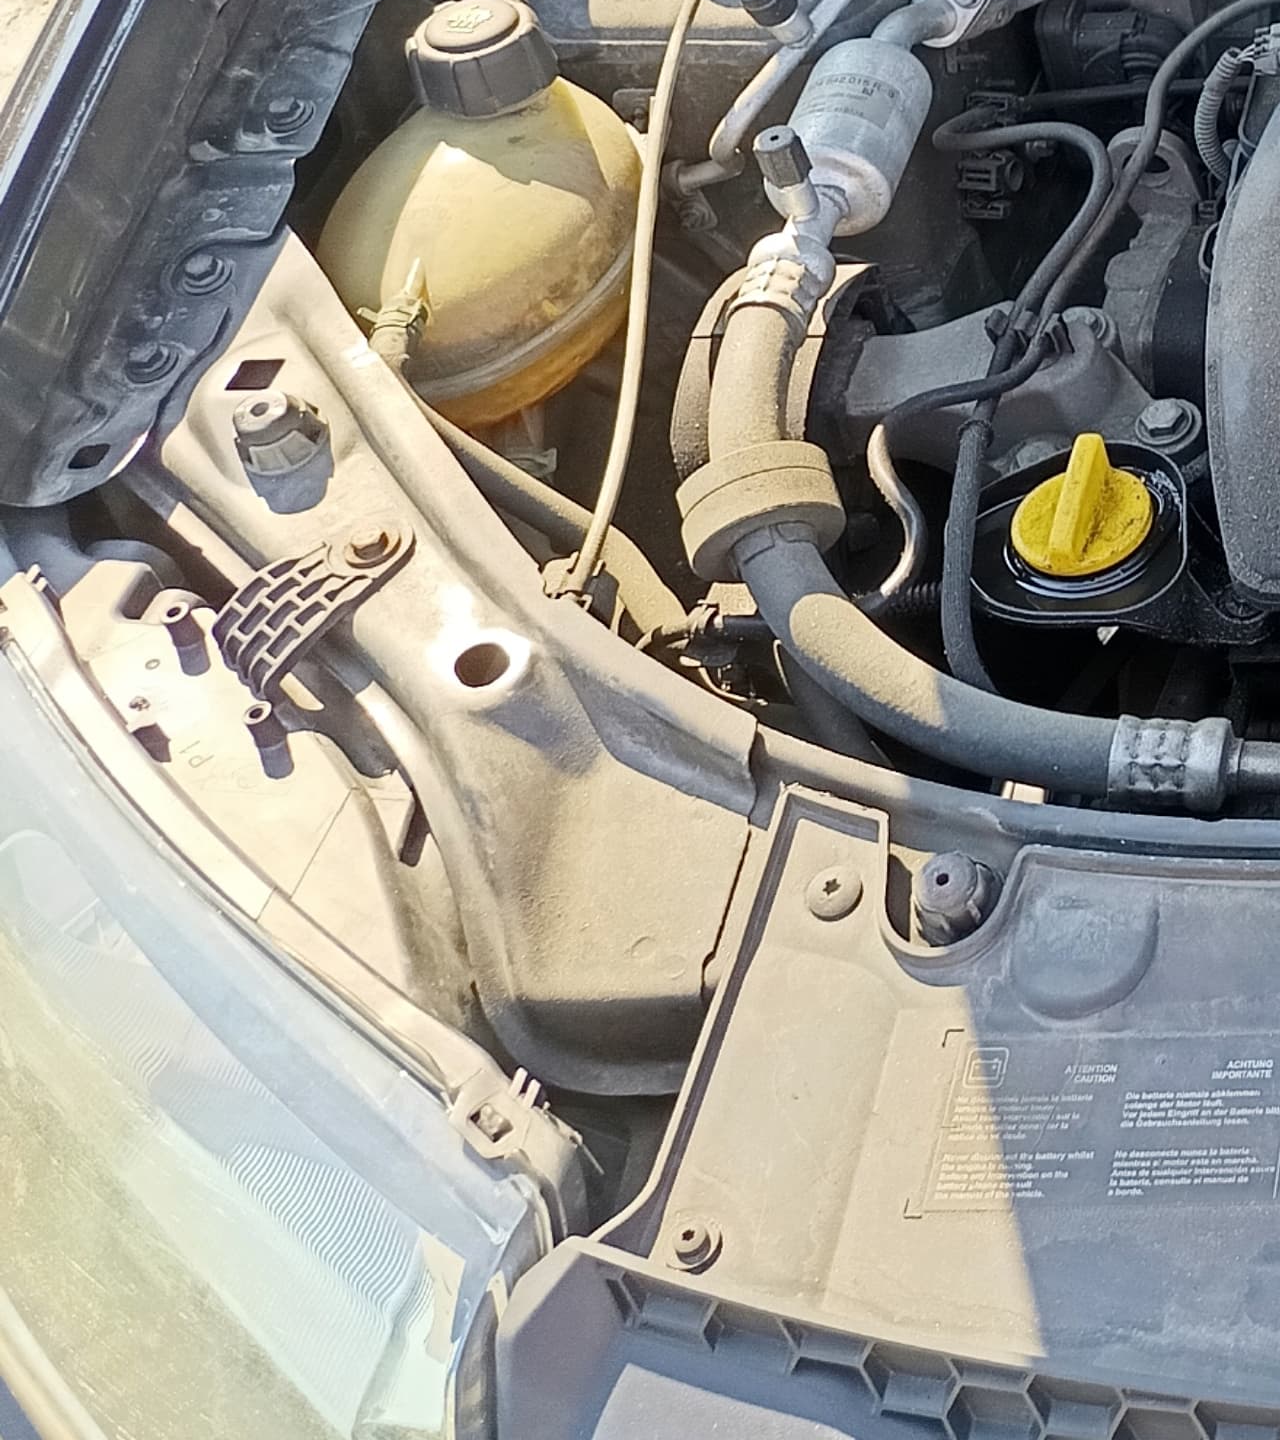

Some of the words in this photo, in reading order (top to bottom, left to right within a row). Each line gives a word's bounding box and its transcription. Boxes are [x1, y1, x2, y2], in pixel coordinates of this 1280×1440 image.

[1227, 1059, 1273, 1069] ACHTUNG
[1065, 1064, 1118, 1074] ATTENTION
[1074, 1074, 1116, 1083] CAUTION
[1212, 1070, 1272, 1079] IMPORTANTE
